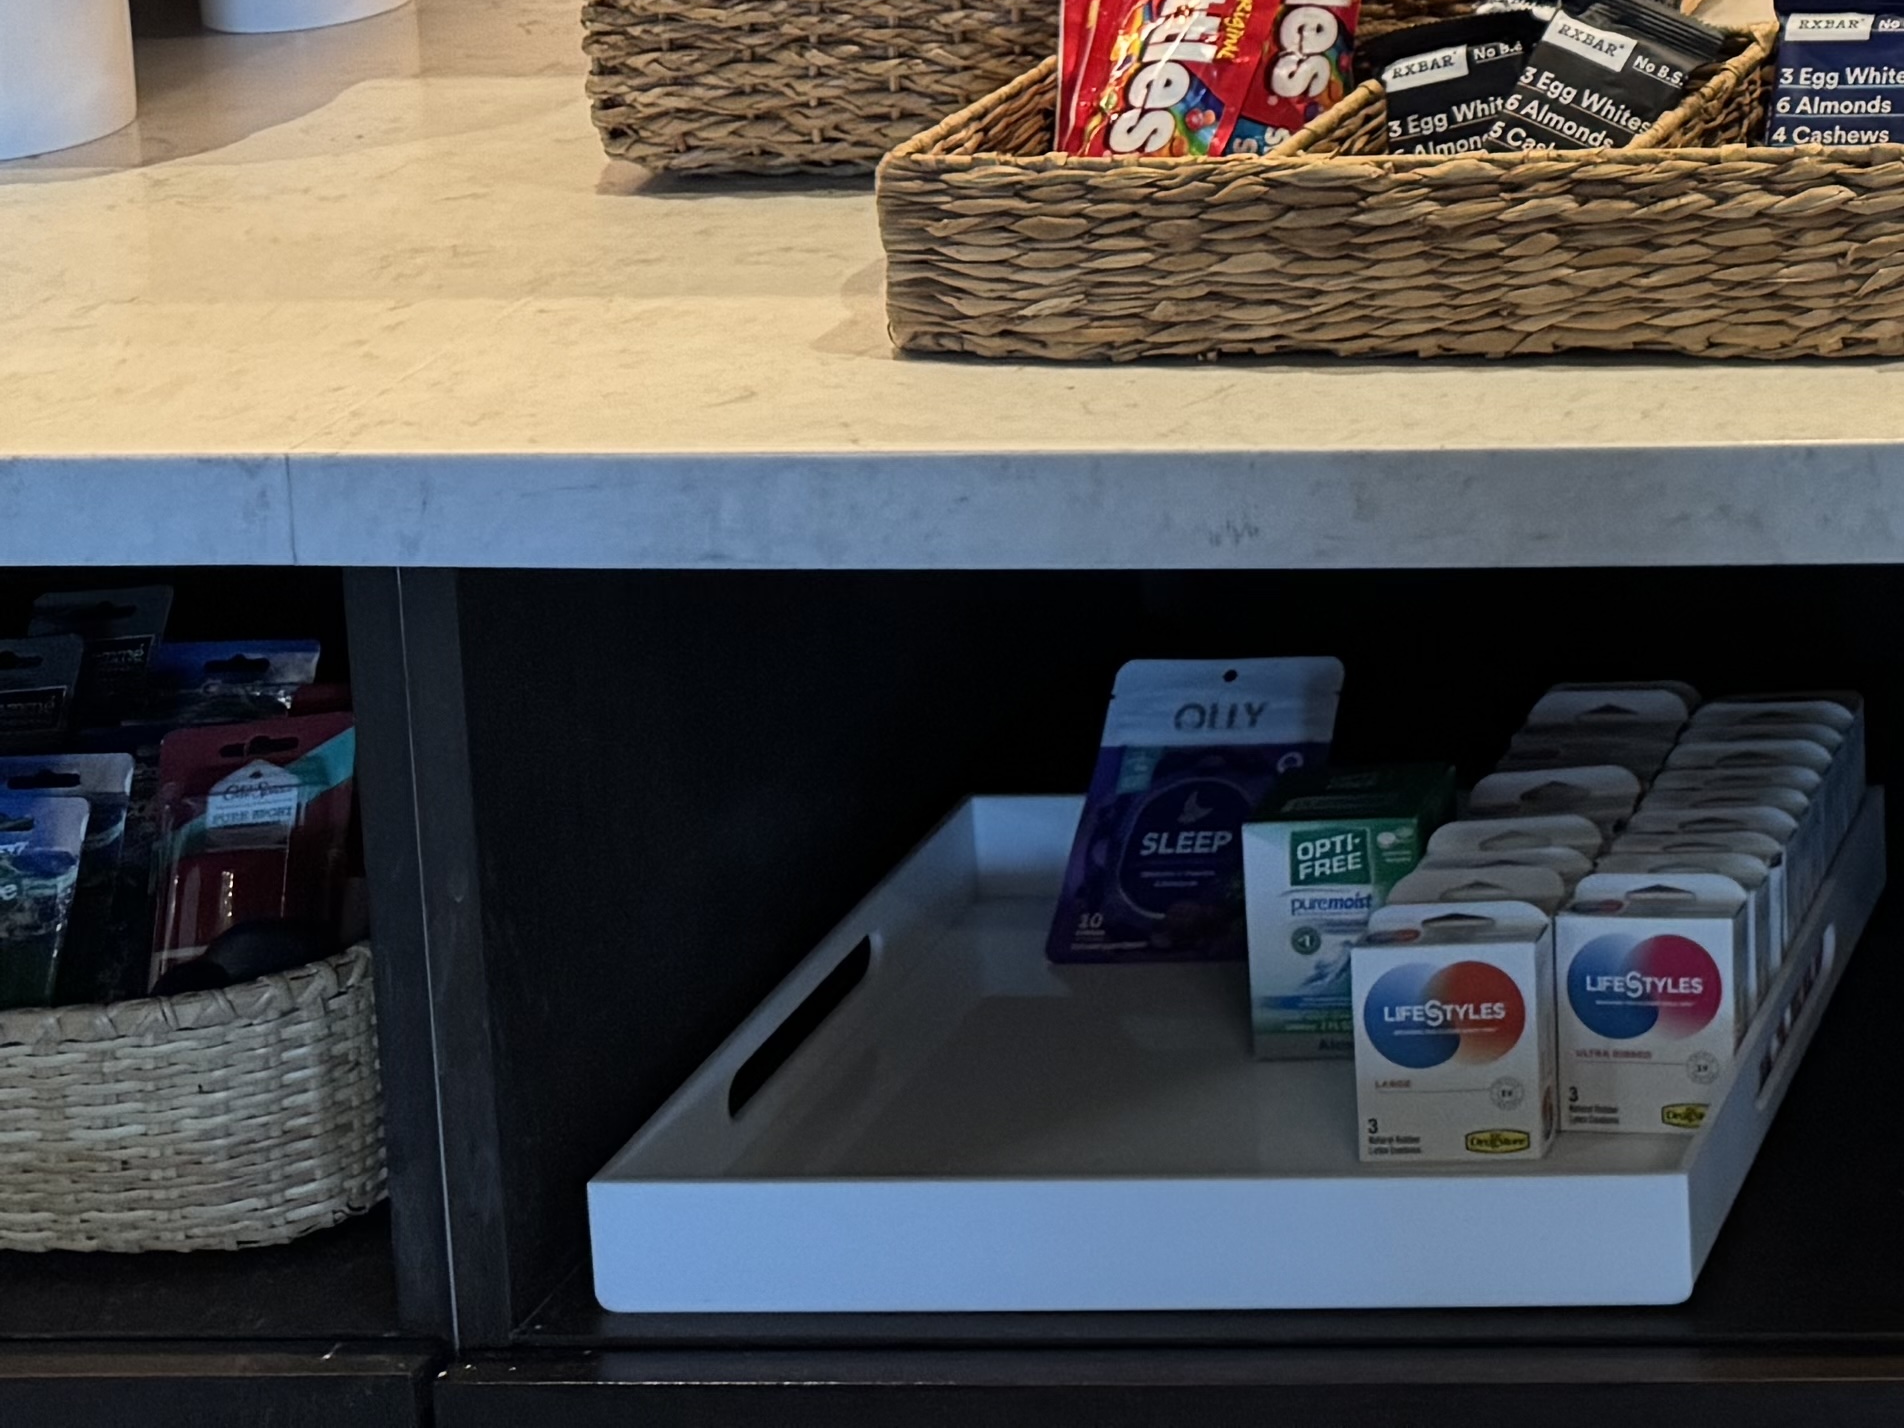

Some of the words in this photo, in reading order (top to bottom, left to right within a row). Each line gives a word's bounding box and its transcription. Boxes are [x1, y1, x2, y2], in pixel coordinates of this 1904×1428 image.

[1799, 18, 1861, 30] RXBAR
[1879, 18, 1901, 30] No
[1558, 23, 1619, 57] RXBAR
[1392, 55, 1454, 80] RXBAR
[1473, 47, 1496, 59] No
[1633, 55, 1656, 74] No
[1780, 68, 1794, 84] 3
[1800, 69, 1839, 90] Egg
[1519, 66, 1535, 84] 3
[1536, 71, 1577, 105] Egg
[1582, 88, 1652, 135] Whites
[1776, 99, 1790, 113] 6
[1796, 95, 1892, 114] Almonds
[1388, 120, 1402, 137] 3
[1406, 110, 1448, 135] Egg
[1489, 121, 1506, 137] 5
[1505, 94, 1522, 111] 6
[1524, 99, 1614, 149] Almonds
[1772, 128, 1787, 143] 4
[1792, 126, 1890, 144] Cashews
[1174, 702, 1266, 732] OLLY
[1140, 830, 1233, 856] SLEEP
[1296, 834, 1361, 861] OPTI-
[1299, 852, 1362, 880] FREE
[1291, 893, 1372, 915] puremoist
[1077, 913, 1104, 929] 10
[1586, 972, 1703, 999] LIFESTYLES
[1384, 999, 1506, 1027] LIFESTYLES
[1569, 1087, 1579, 1102] 3
[1367, 1118, 1379, 1135] 3
